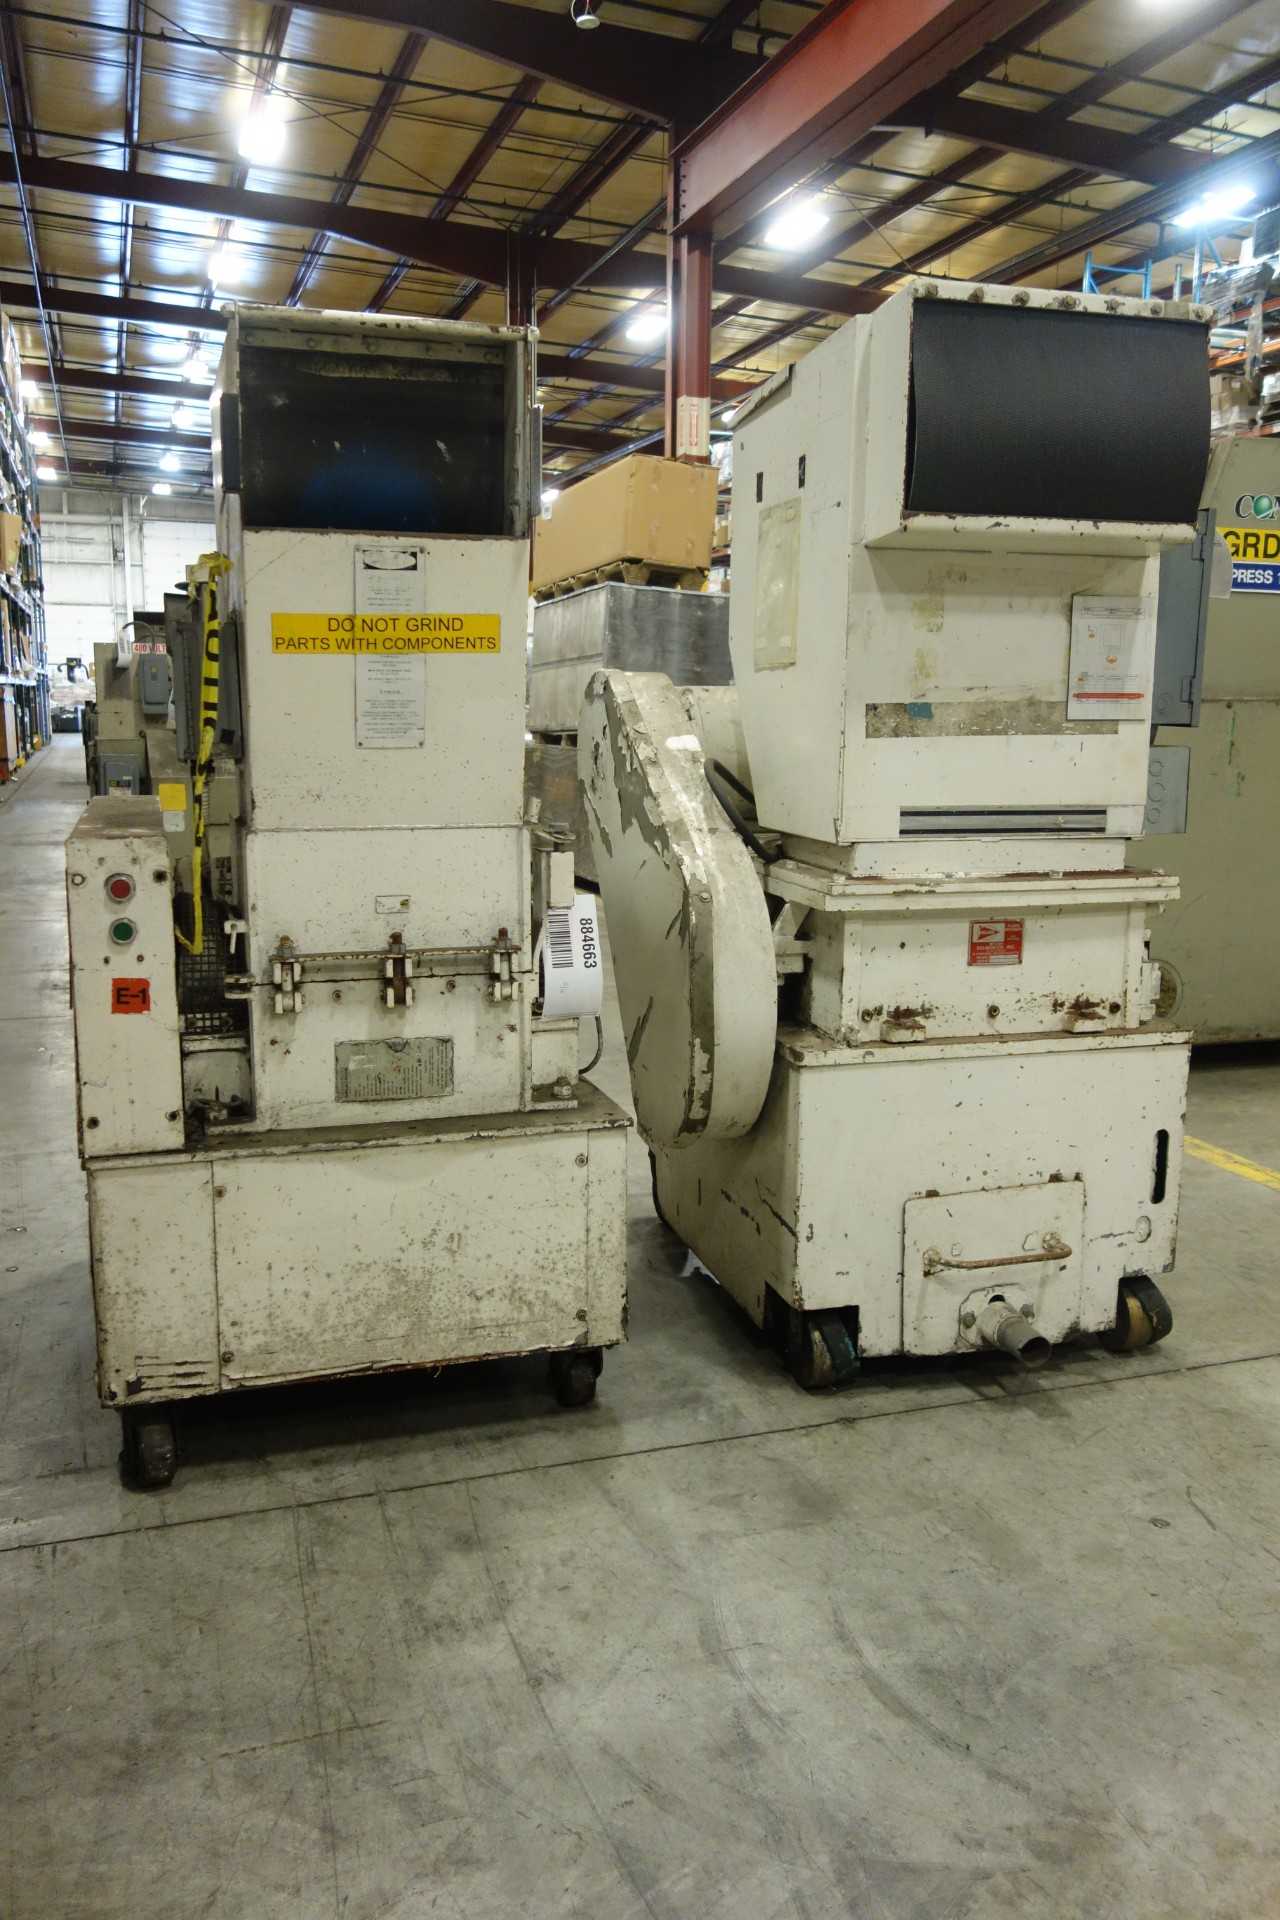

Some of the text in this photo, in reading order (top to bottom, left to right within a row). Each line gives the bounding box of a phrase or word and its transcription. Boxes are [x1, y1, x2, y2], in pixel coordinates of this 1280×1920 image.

[327, 617, 464, 632] DO NOT GRIND
[274, 636, 497, 651] PARTS WITH COMPONENTS
[579, 917, 598, 969] 884663
[116, 987, 147, 1005] E-1
